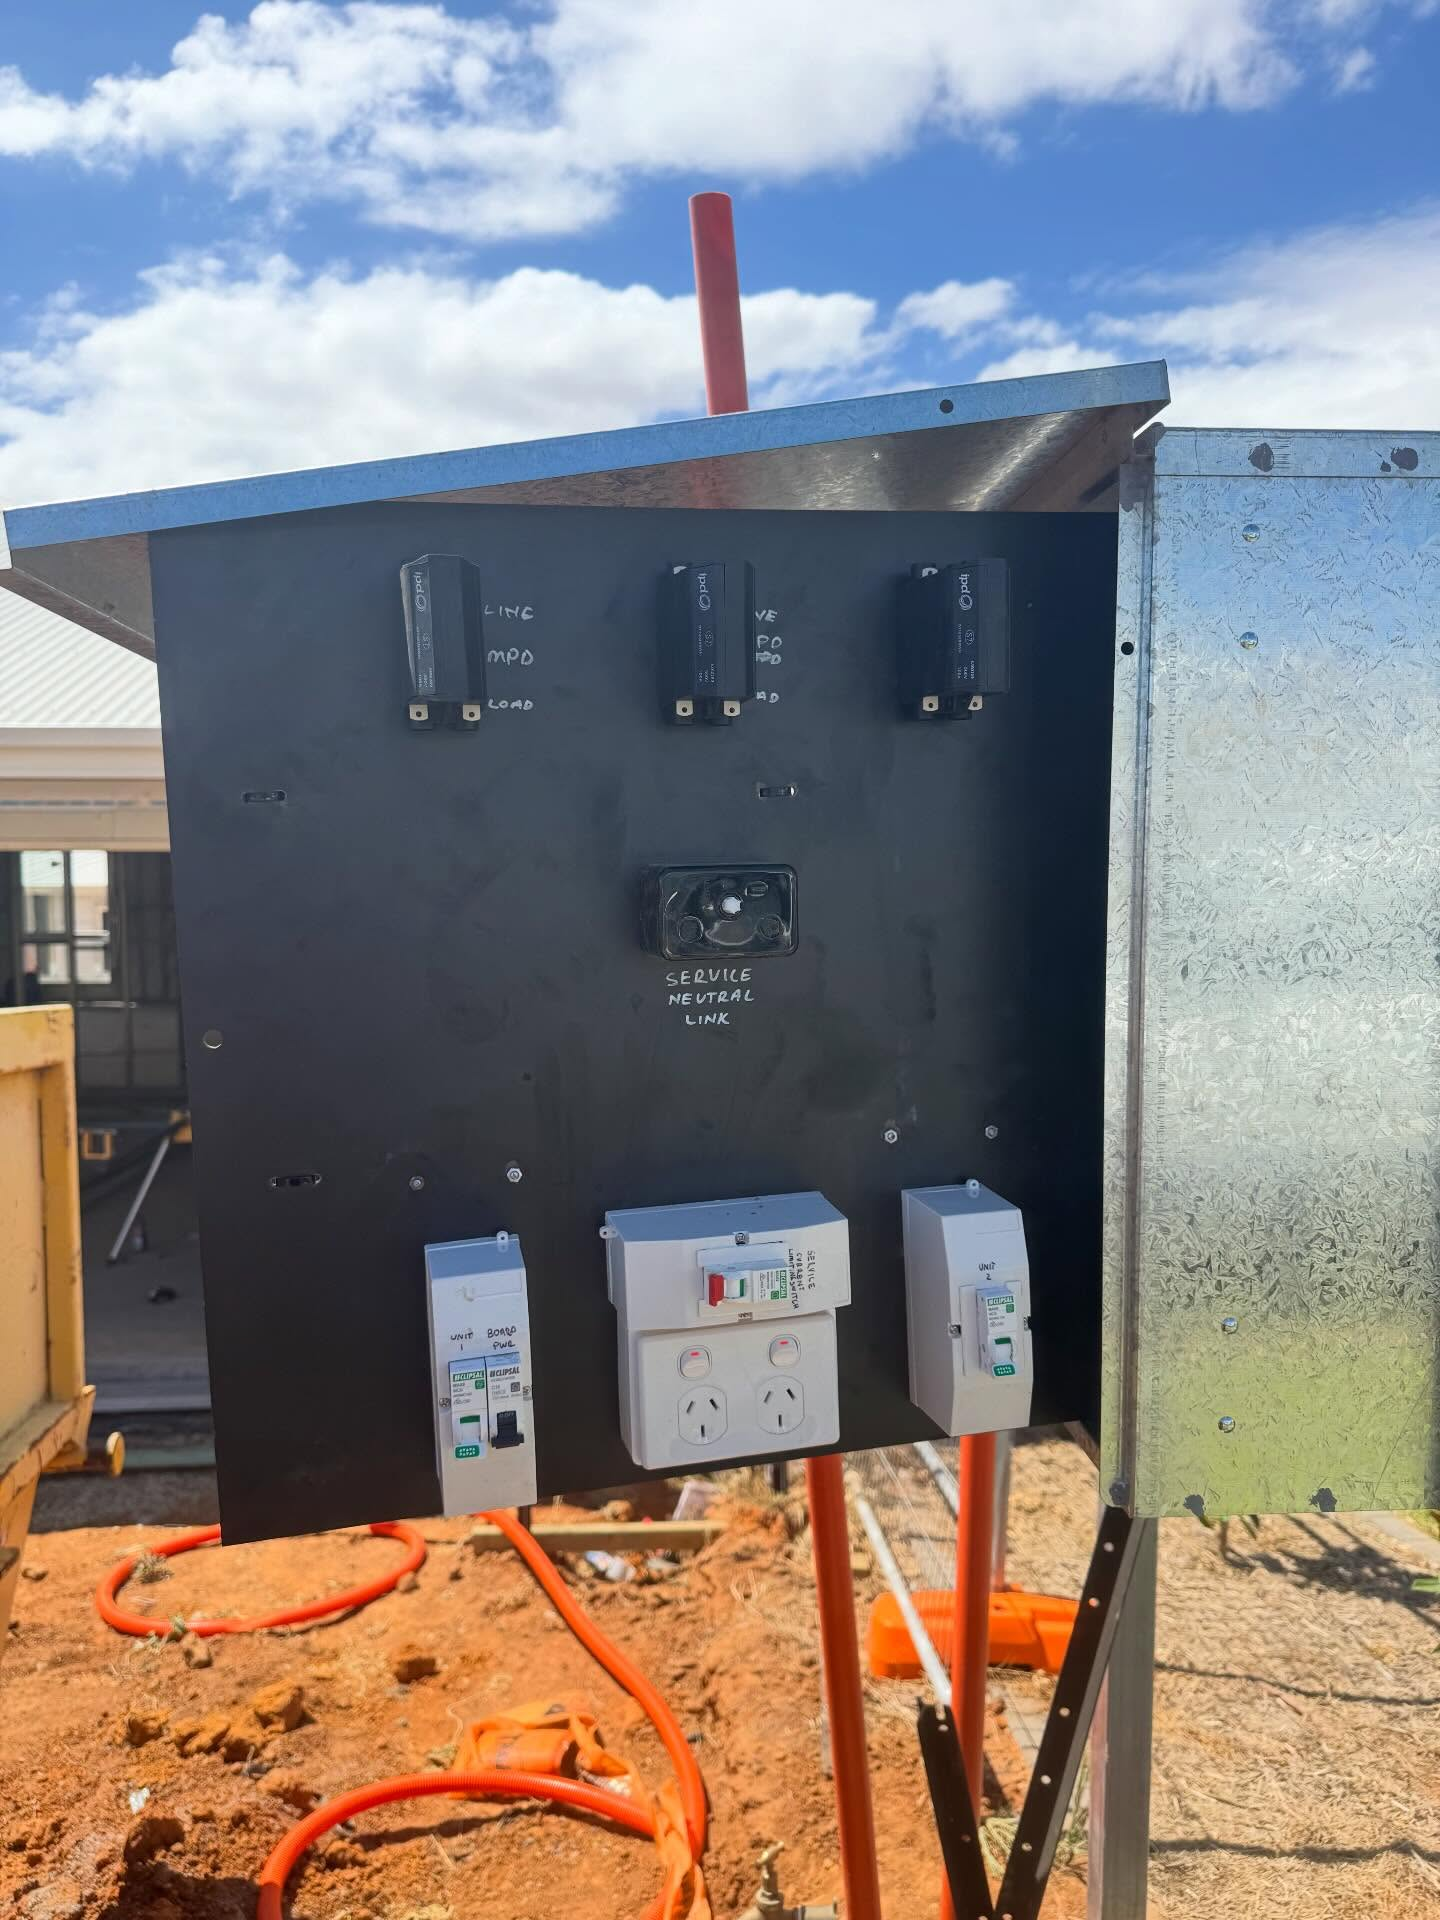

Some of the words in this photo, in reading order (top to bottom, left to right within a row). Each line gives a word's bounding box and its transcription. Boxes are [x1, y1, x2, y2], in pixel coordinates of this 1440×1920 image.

[959, 573, 971, 594] ipd
[484, 605, 534, 620] LINE
[487, 647, 534, 666] MPD
[487, 699, 534, 711] LOAD
[665, 968, 753, 987] SERVICE
[668, 988, 755, 1006] NEUTRAL
[685, 1012, 730, 1025] LINK
[978, 1261, 996, 1272] UNIT
[985, 1273, 992, 1281] 2
[450, 1331, 474, 1341] UNIT
[487, 1325, 517, 1338] BOARD
[492, 1341, 516, 1350] PWR
[495, 1366, 521, 1378] CLIPSAL
